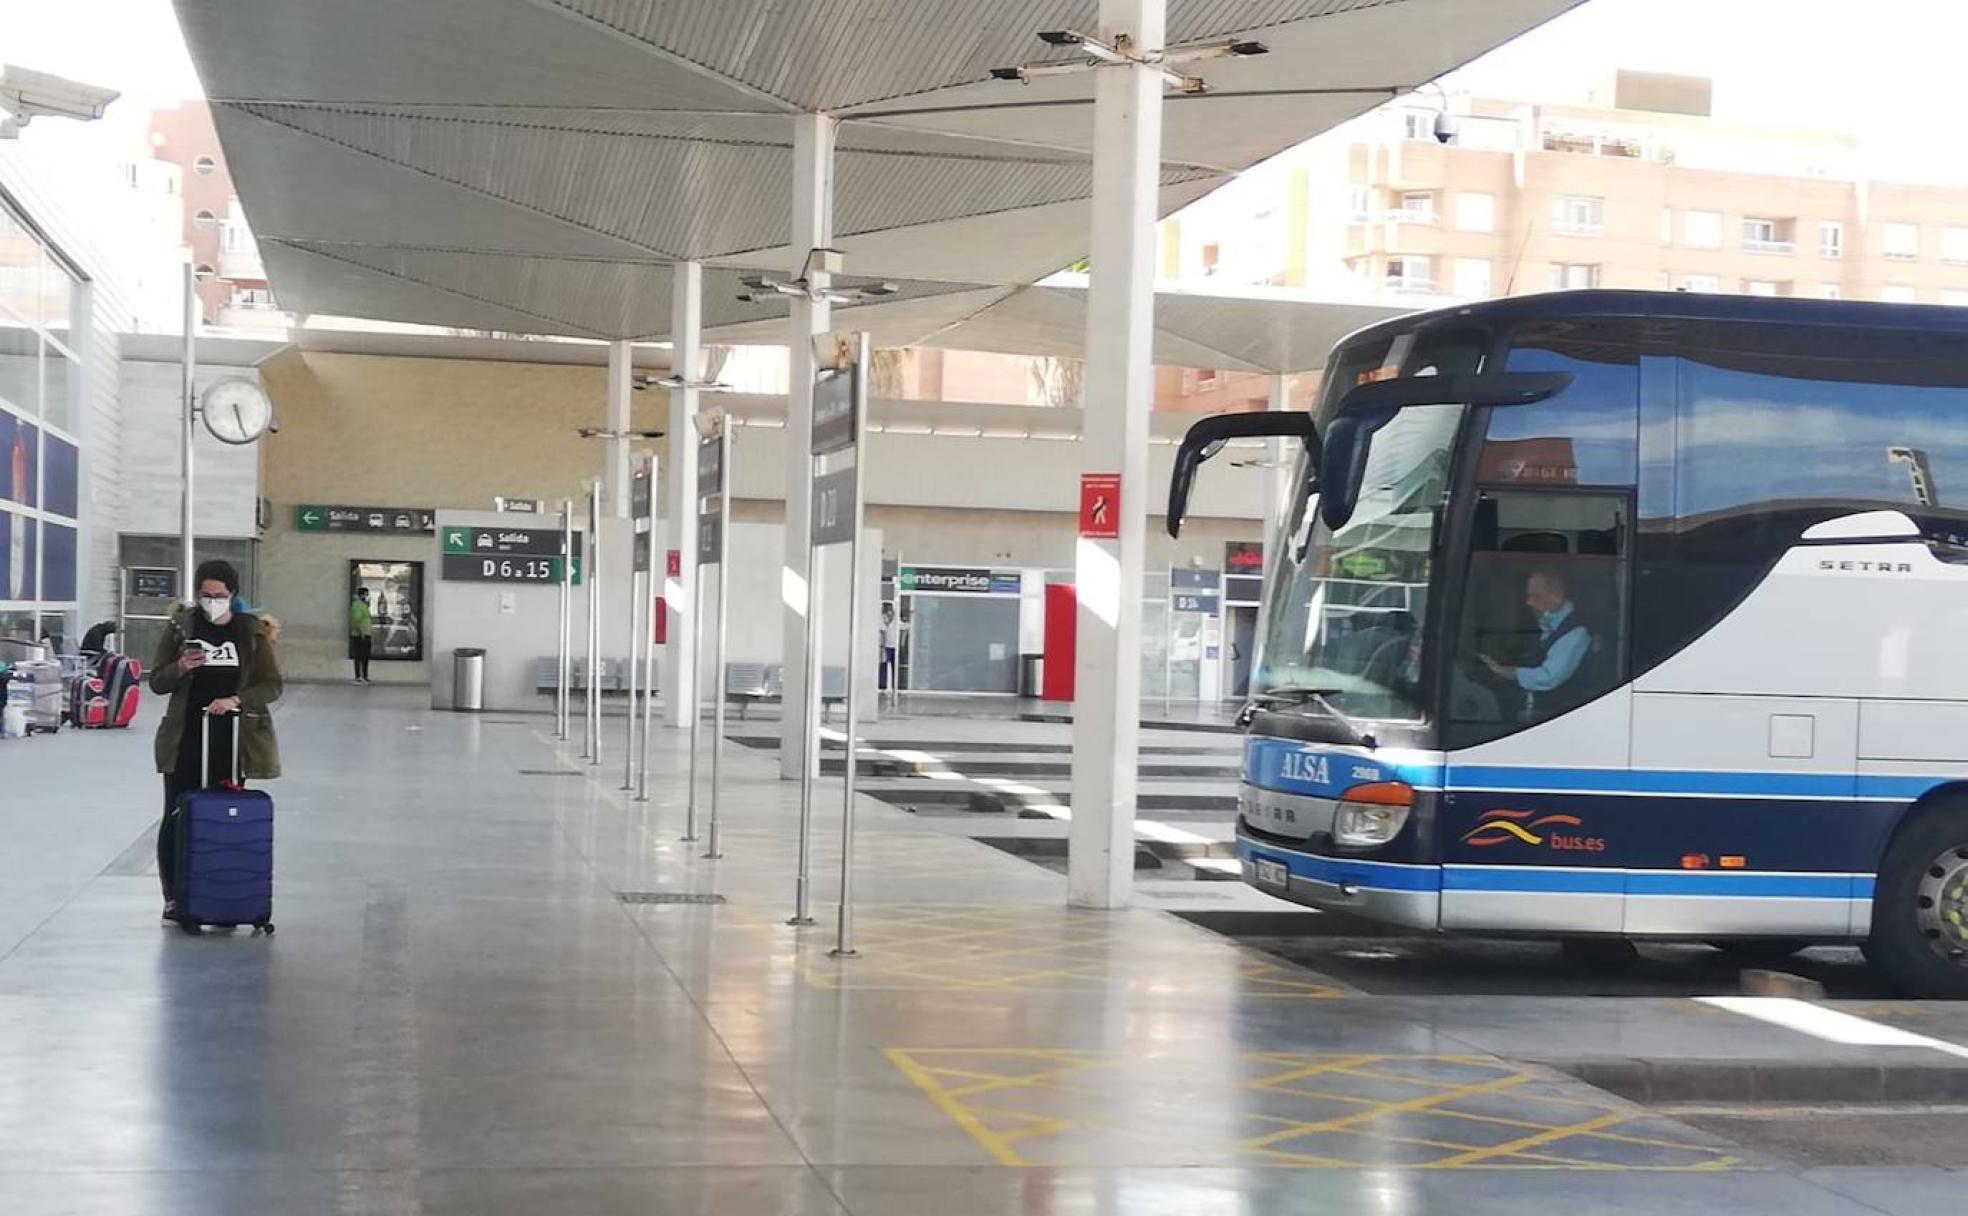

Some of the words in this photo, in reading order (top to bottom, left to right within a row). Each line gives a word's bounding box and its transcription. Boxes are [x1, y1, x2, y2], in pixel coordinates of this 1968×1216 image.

[498, 533, 529, 544] Salida
[483, 560, 496, 577] D
[1818, 560, 1912, 572] SETRA
[901, 573, 989, 588] enterprise
[1280, 752, 1330, 785] ALSA
[1551, 832, 1605, 851] bus.es
